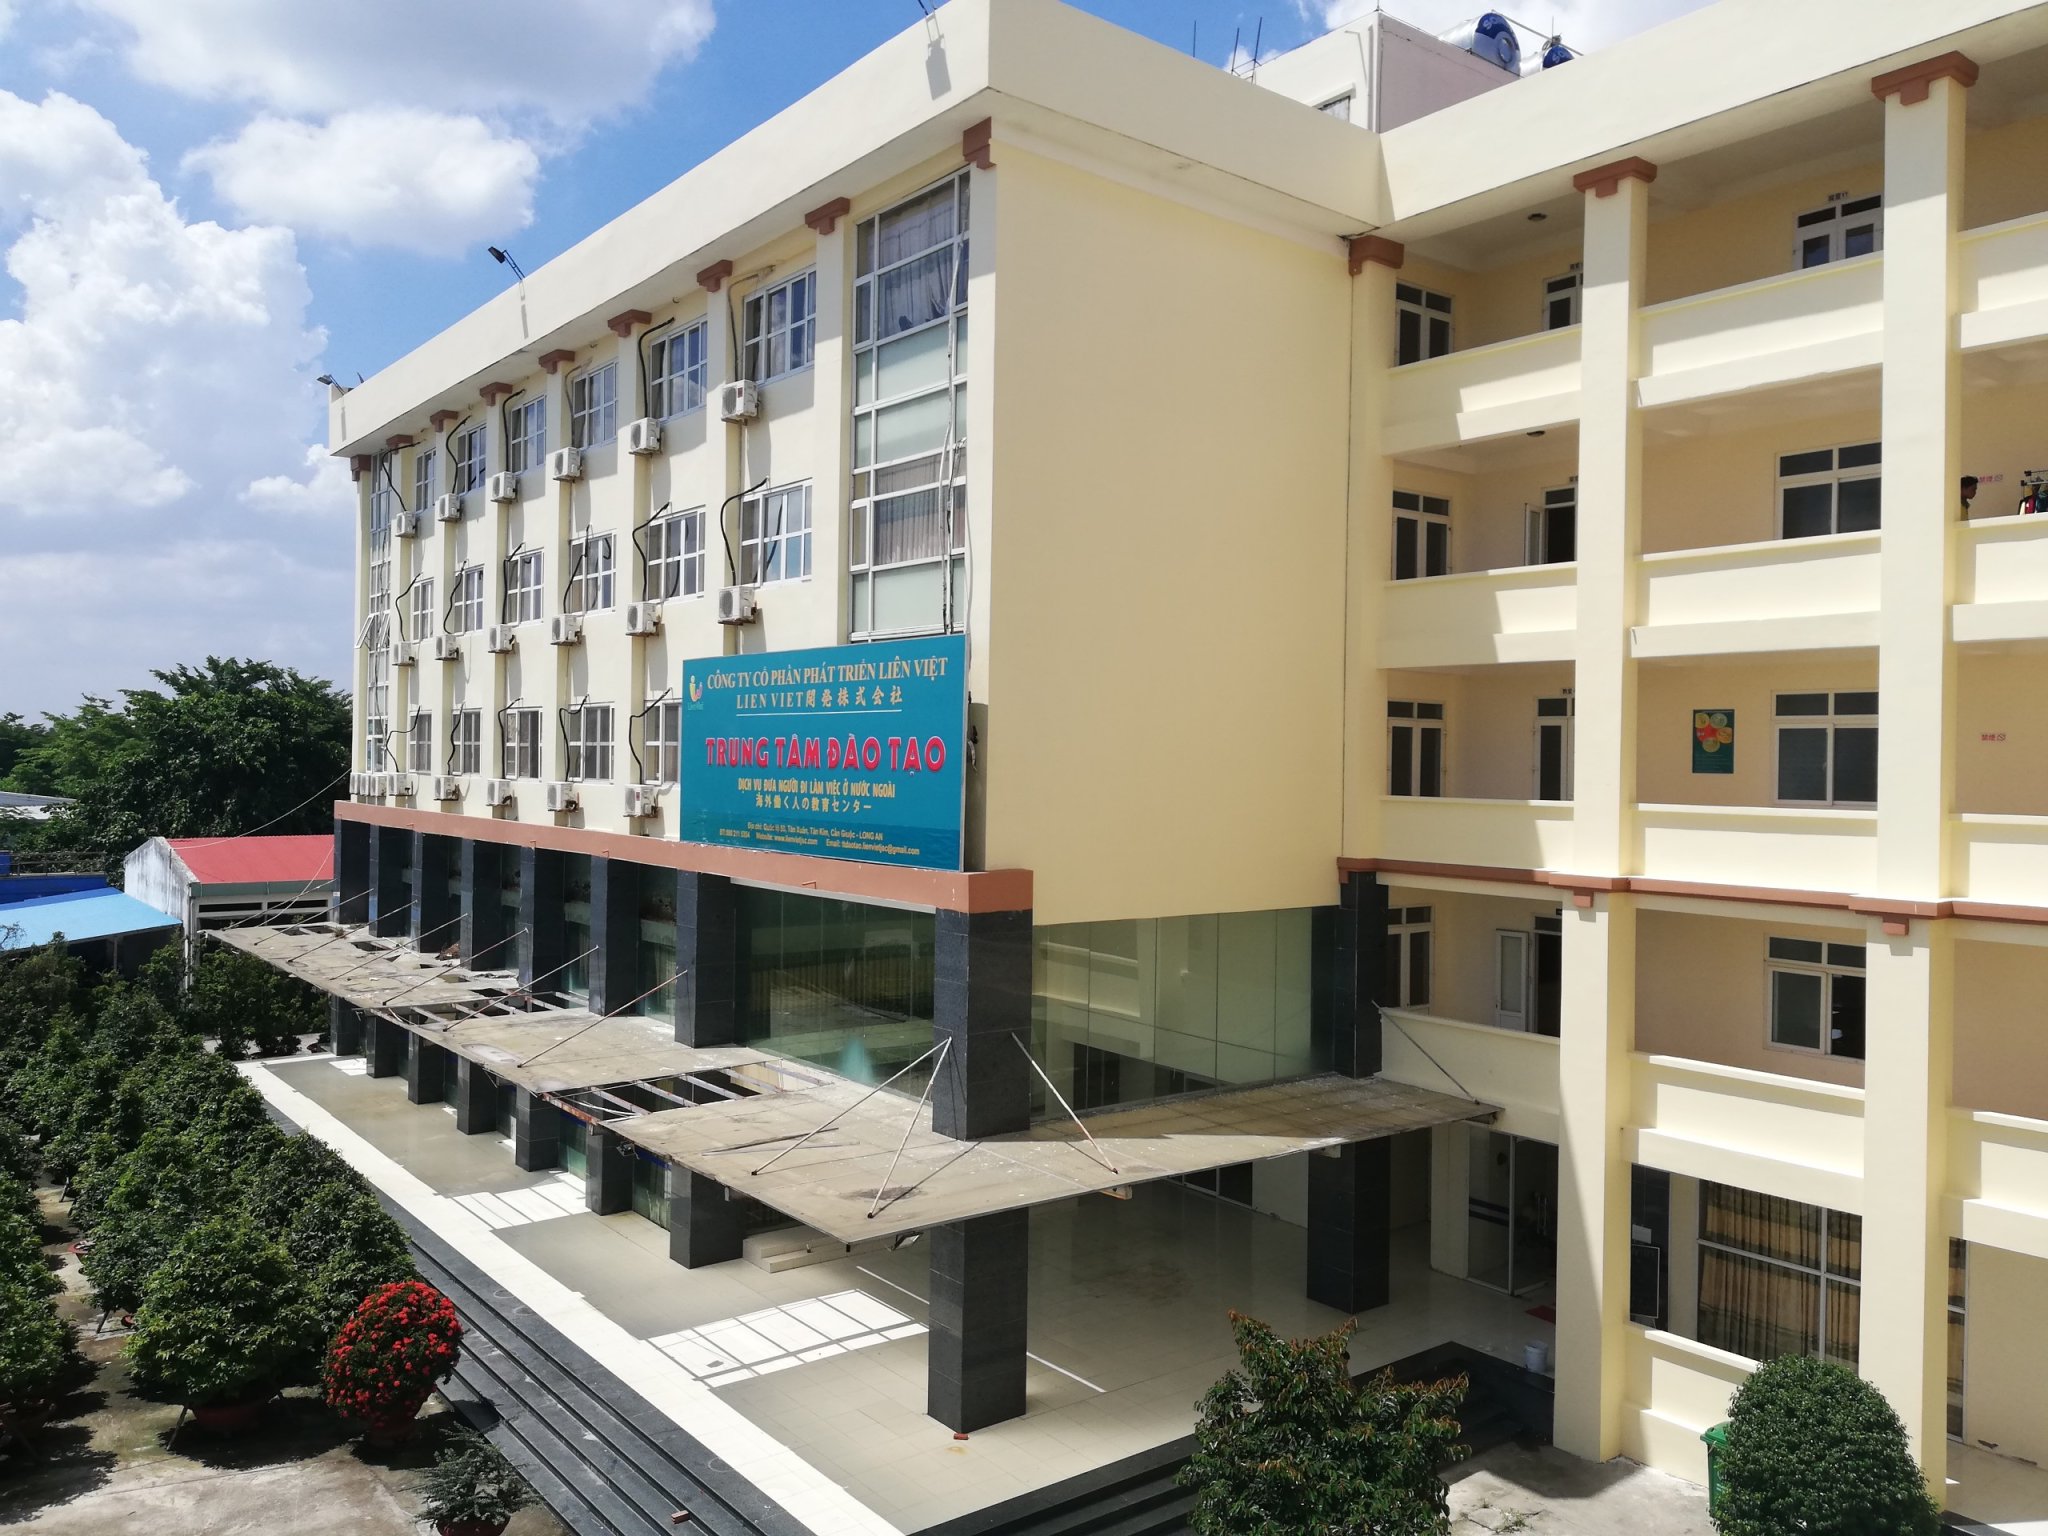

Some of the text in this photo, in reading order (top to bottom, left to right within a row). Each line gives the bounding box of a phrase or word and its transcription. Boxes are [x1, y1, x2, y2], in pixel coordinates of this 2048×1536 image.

[707, 655, 948, 690] CÔNG TY CỔ PHẦN PHÁT TRIỂN LIÊN VIỆT
[736, 693, 768, 709] LIEN
[770, 691, 804, 708] VIET
[705, 733, 947, 776] TRUNG TÂM ĐÀO TẠO
[810, 778, 824, 795] LÀM
[872, 781, 896, 798] NGOÀI
[859, 831, 875, 840] LONG
[875, 832, 884, 841] AN
